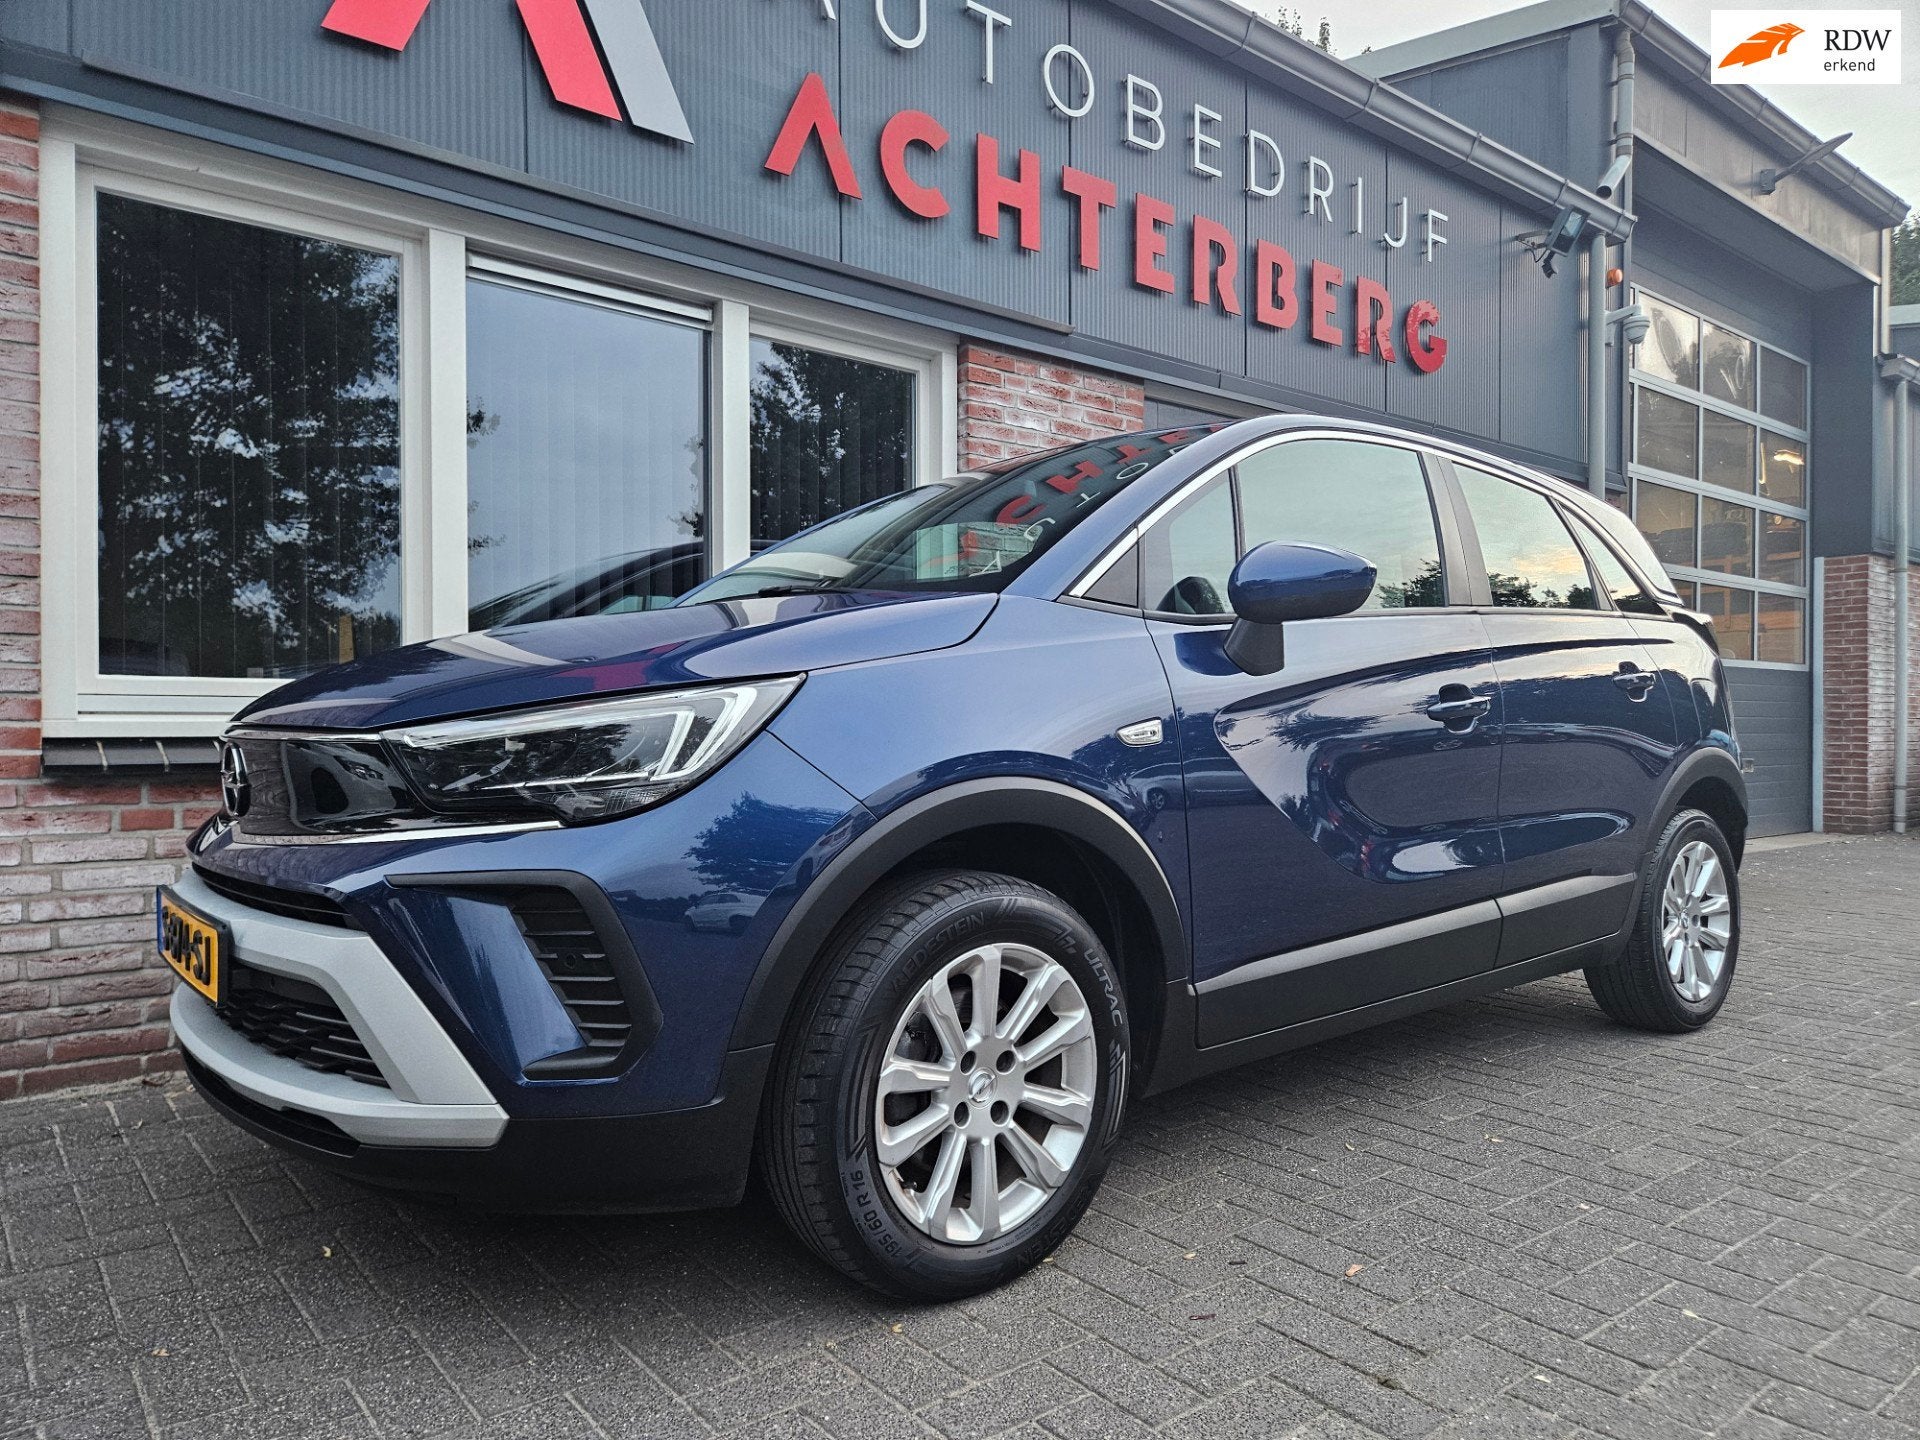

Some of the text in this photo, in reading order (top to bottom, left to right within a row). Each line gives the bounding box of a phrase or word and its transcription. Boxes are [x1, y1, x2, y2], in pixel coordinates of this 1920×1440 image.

[822, 0, 1448, 262] UTOBEDRIJF
[764, 72, 1447, 374] ACHTERBERG
[1083, 948, 1123, 1027] ULTRAC
[856, 1191, 872, 1207] R
[863, 1209, 902, 1258] 195/60
